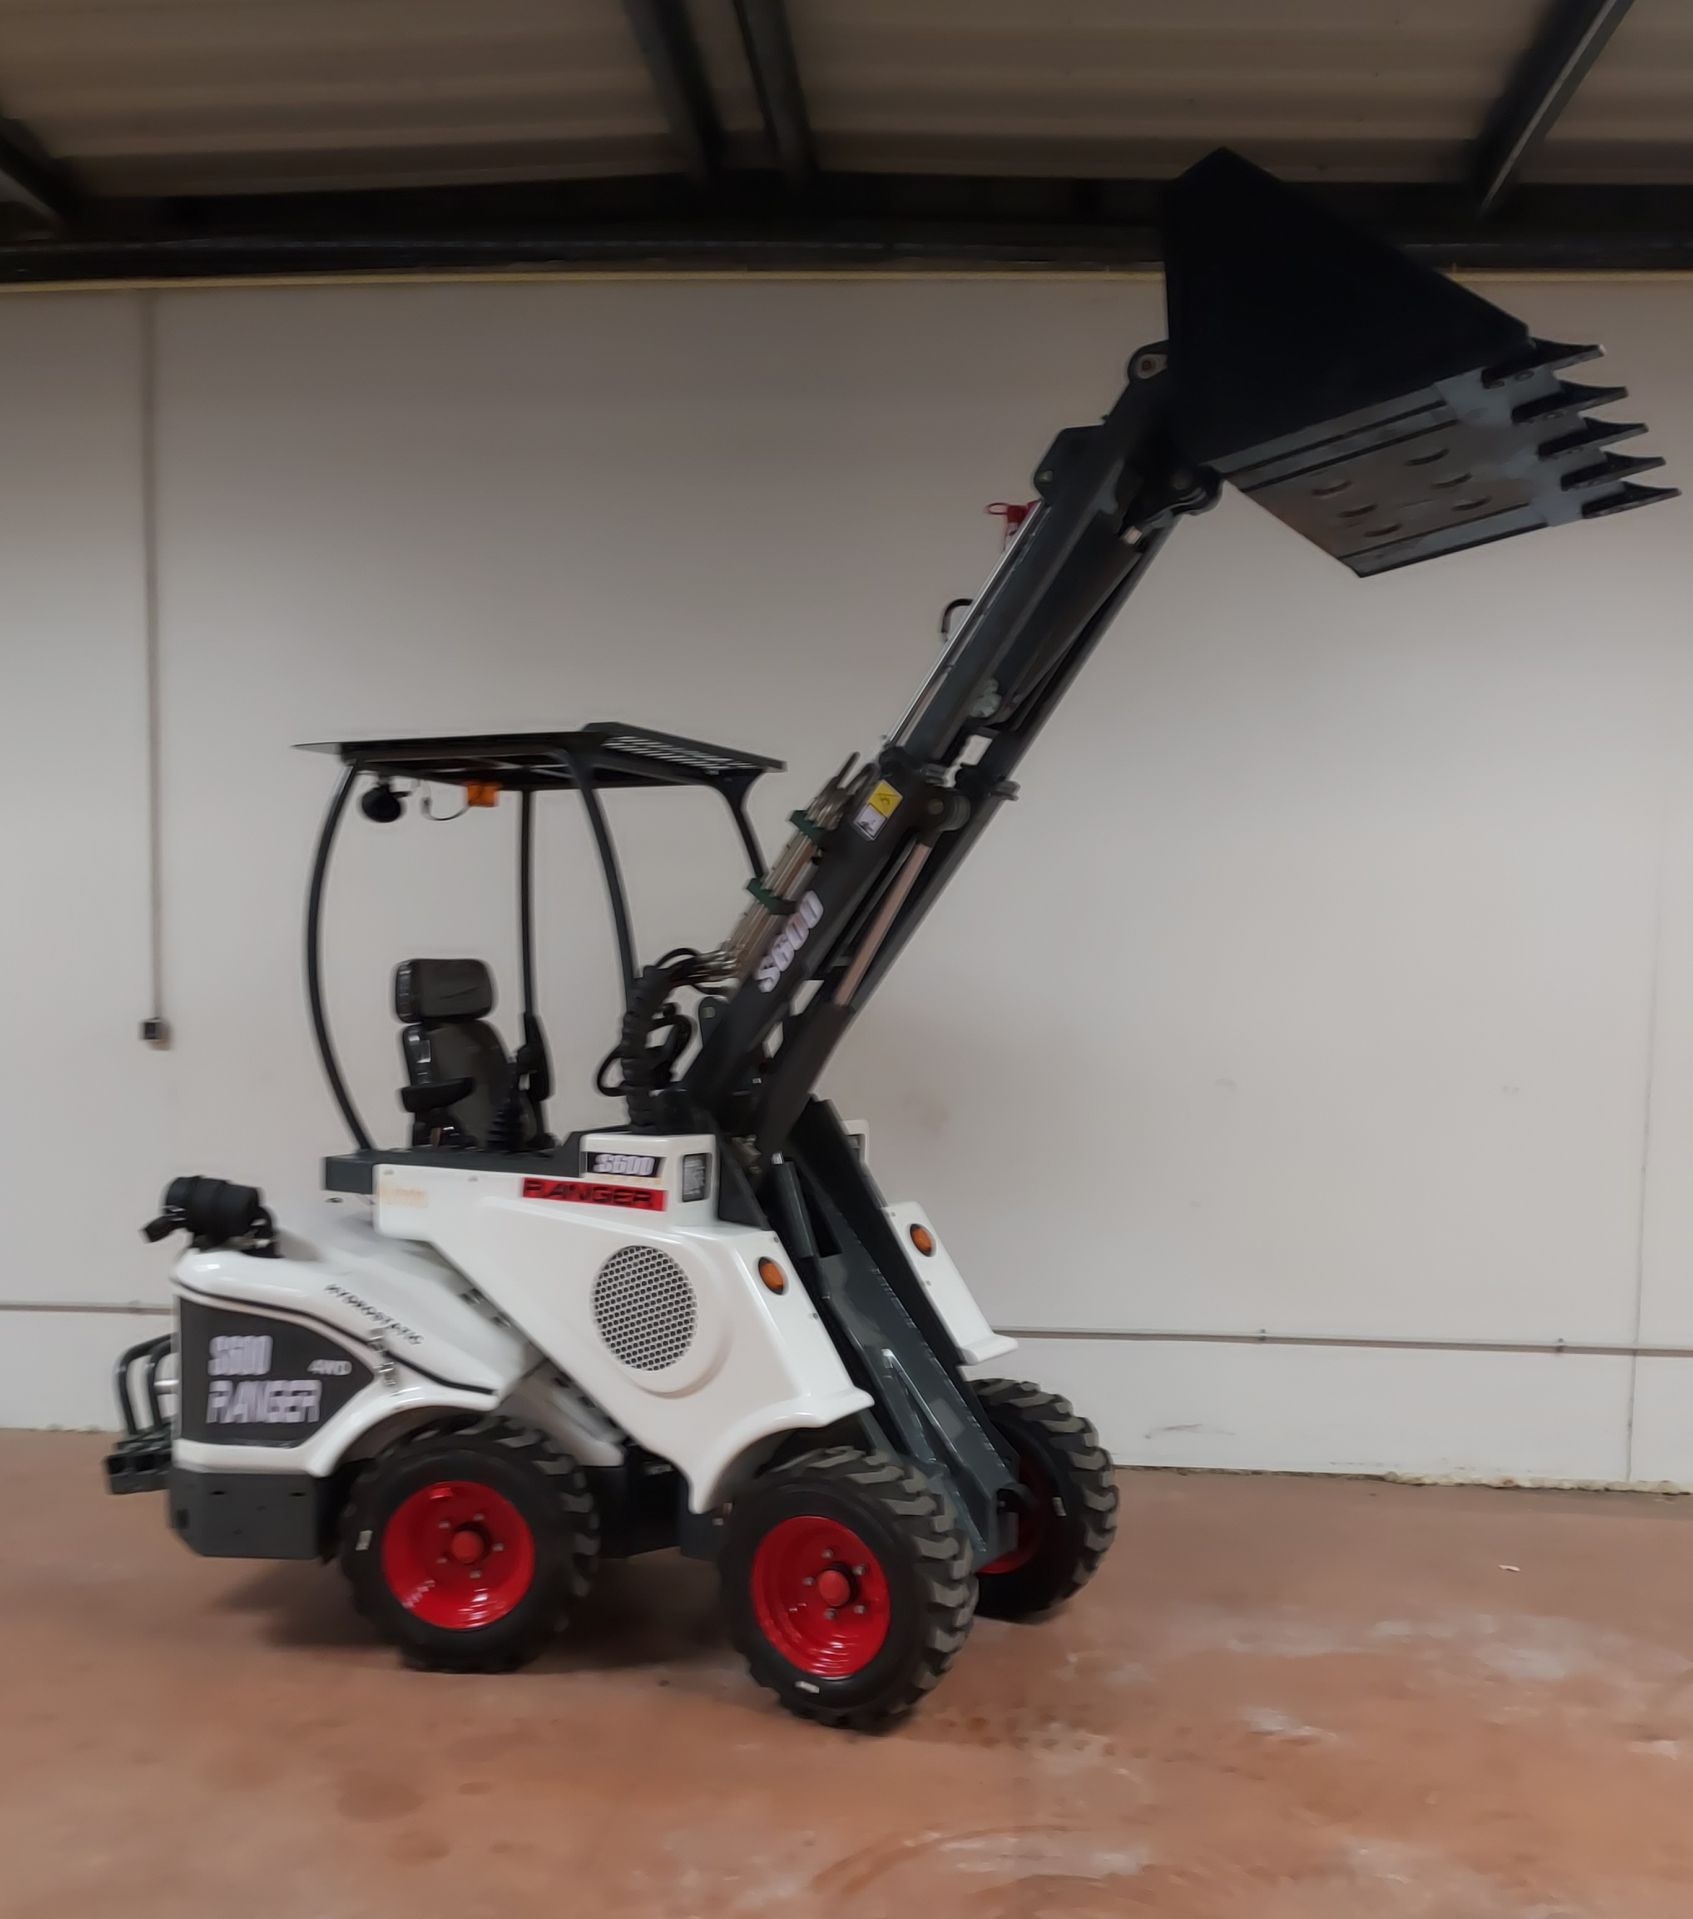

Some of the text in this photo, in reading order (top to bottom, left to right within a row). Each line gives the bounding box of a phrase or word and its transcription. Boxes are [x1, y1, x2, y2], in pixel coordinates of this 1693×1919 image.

[757, 889, 824, 993] S600
[593, 1153, 656, 1176] S600
[523, 1179, 655, 1209] RANGER
[206, 1379, 322, 1424] RANGER
